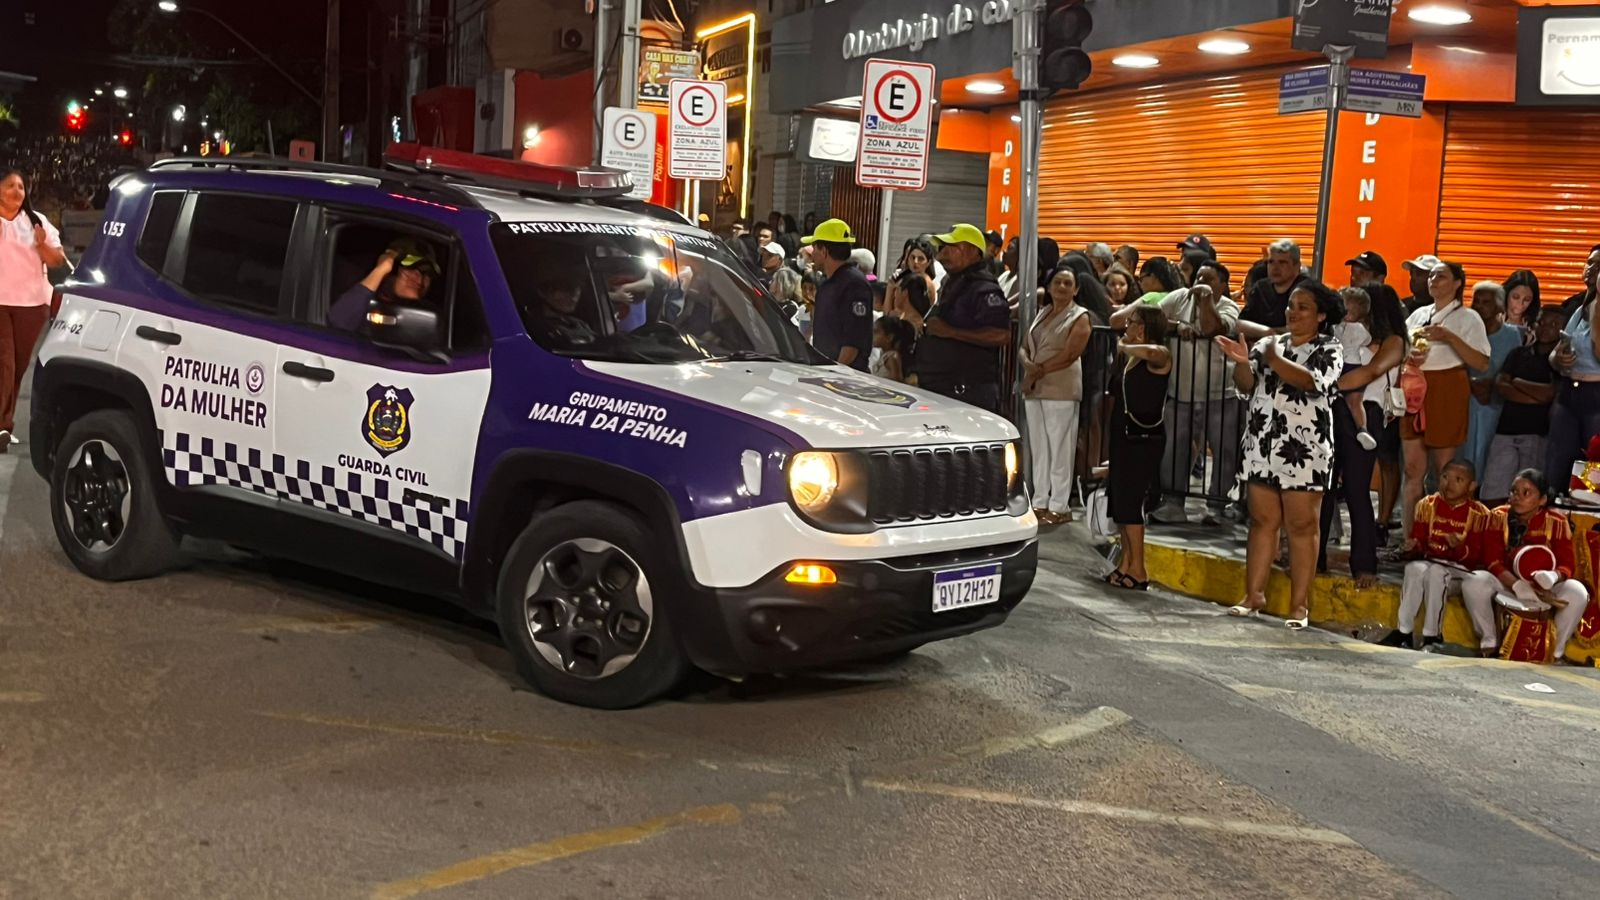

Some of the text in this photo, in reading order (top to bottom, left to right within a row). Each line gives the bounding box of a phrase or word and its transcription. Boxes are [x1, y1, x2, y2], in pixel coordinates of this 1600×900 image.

[947, 4, 973, 35] de
[982, 0, 1013, 25] co
[692, 96, 703, 116] E
[889, 83, 906, 110] E
[624, 122, 636, 141] E
[675, 137, 696, 145] ZONA
[867, 138, 891, 147] ZONA
[896, 141, 920, 150] AZUL
[654, 142, 664, 181] Popular
[1000, 140, 1013, 262] DENT
[108, 221, 126, 237] 153
[508, 222, 640, 237] PATRULHAMENTO
[164, 356, 240, 389] PATRULHA
[161, 383, 267, 429] DA MULHER
[569, 391, 667, 422] GRUPAMENTO
[528, 402, 688, 448] MARIA DA PENHA
[338, 453, 429, 487] GUARDA CIVIL
